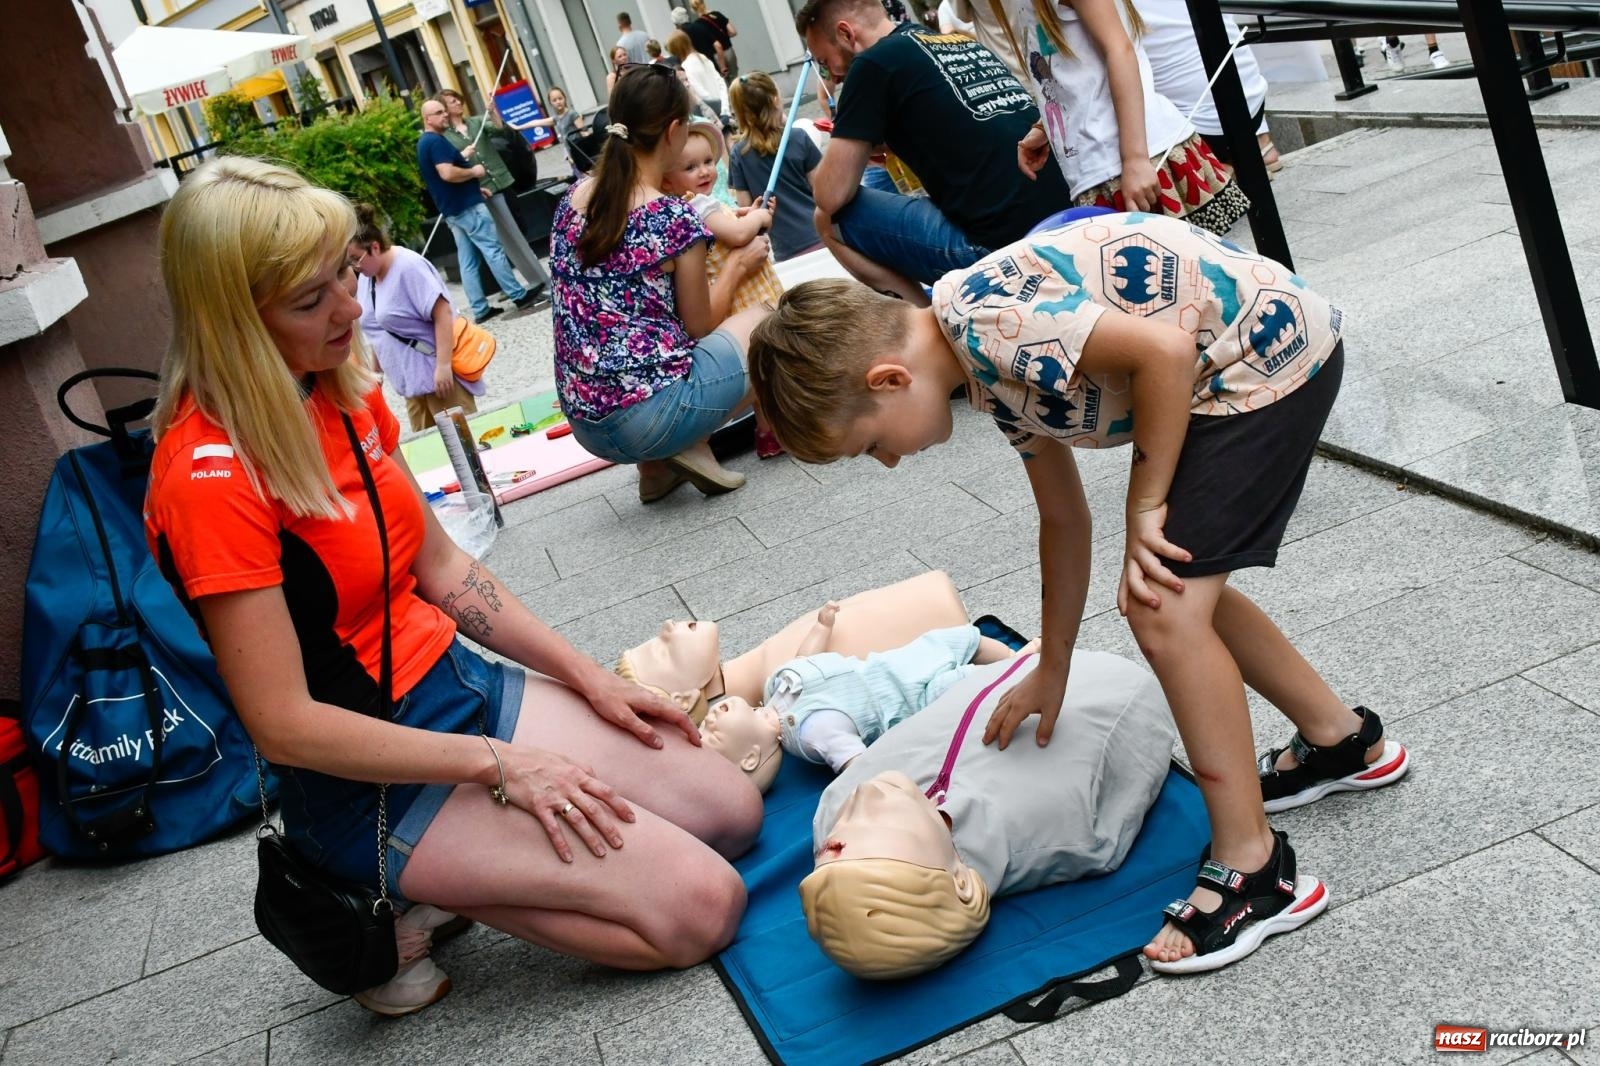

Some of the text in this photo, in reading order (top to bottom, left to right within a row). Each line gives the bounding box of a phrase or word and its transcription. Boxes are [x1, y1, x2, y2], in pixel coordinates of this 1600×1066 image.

[271, 44, 298, 65] ŻYWIEC
[163, 80, 209, 107] ŻYWIEC
[1161, 255, 1176, 301] BATMAN
[1263, 333, 1306, 374] BATMAN
[1081, 387, 1099, 430] BATMAN
[190, 469, 232, 481] POLAND
